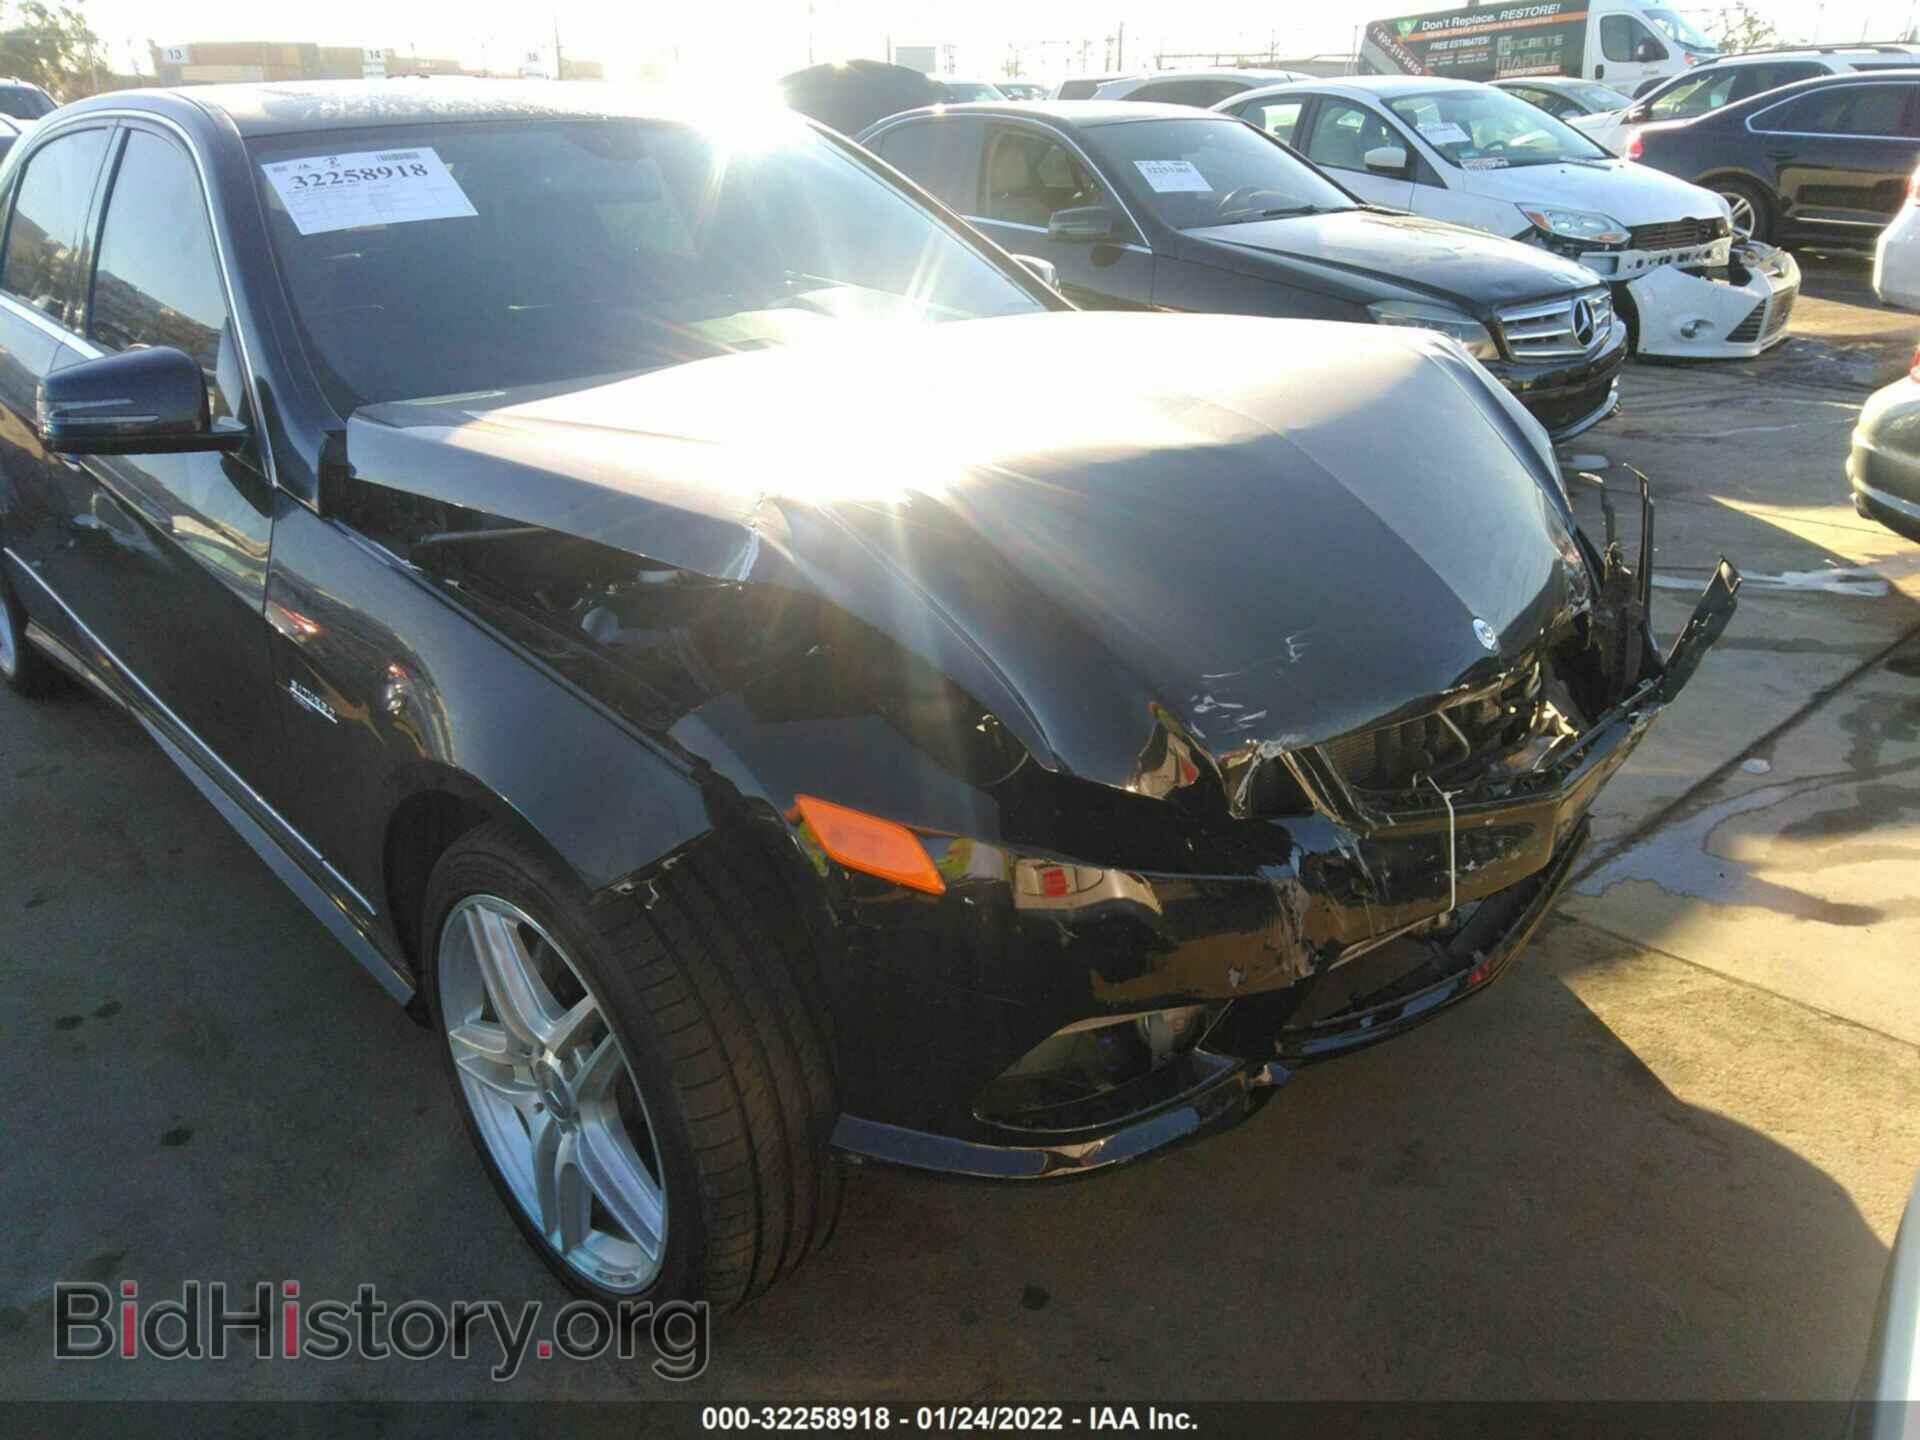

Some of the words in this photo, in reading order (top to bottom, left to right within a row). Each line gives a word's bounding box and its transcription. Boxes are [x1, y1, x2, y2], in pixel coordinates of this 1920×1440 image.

[1422, 17, 1450, 31] Don't
[1452, 13, 1496, 28] Replace.
[1500, 4, 1560, 20] RESTORE!
[168, 48, 183, 60] 13
[1430, 41, 1449, 51] FREE
[290, 163, 428, 190] 32258918
